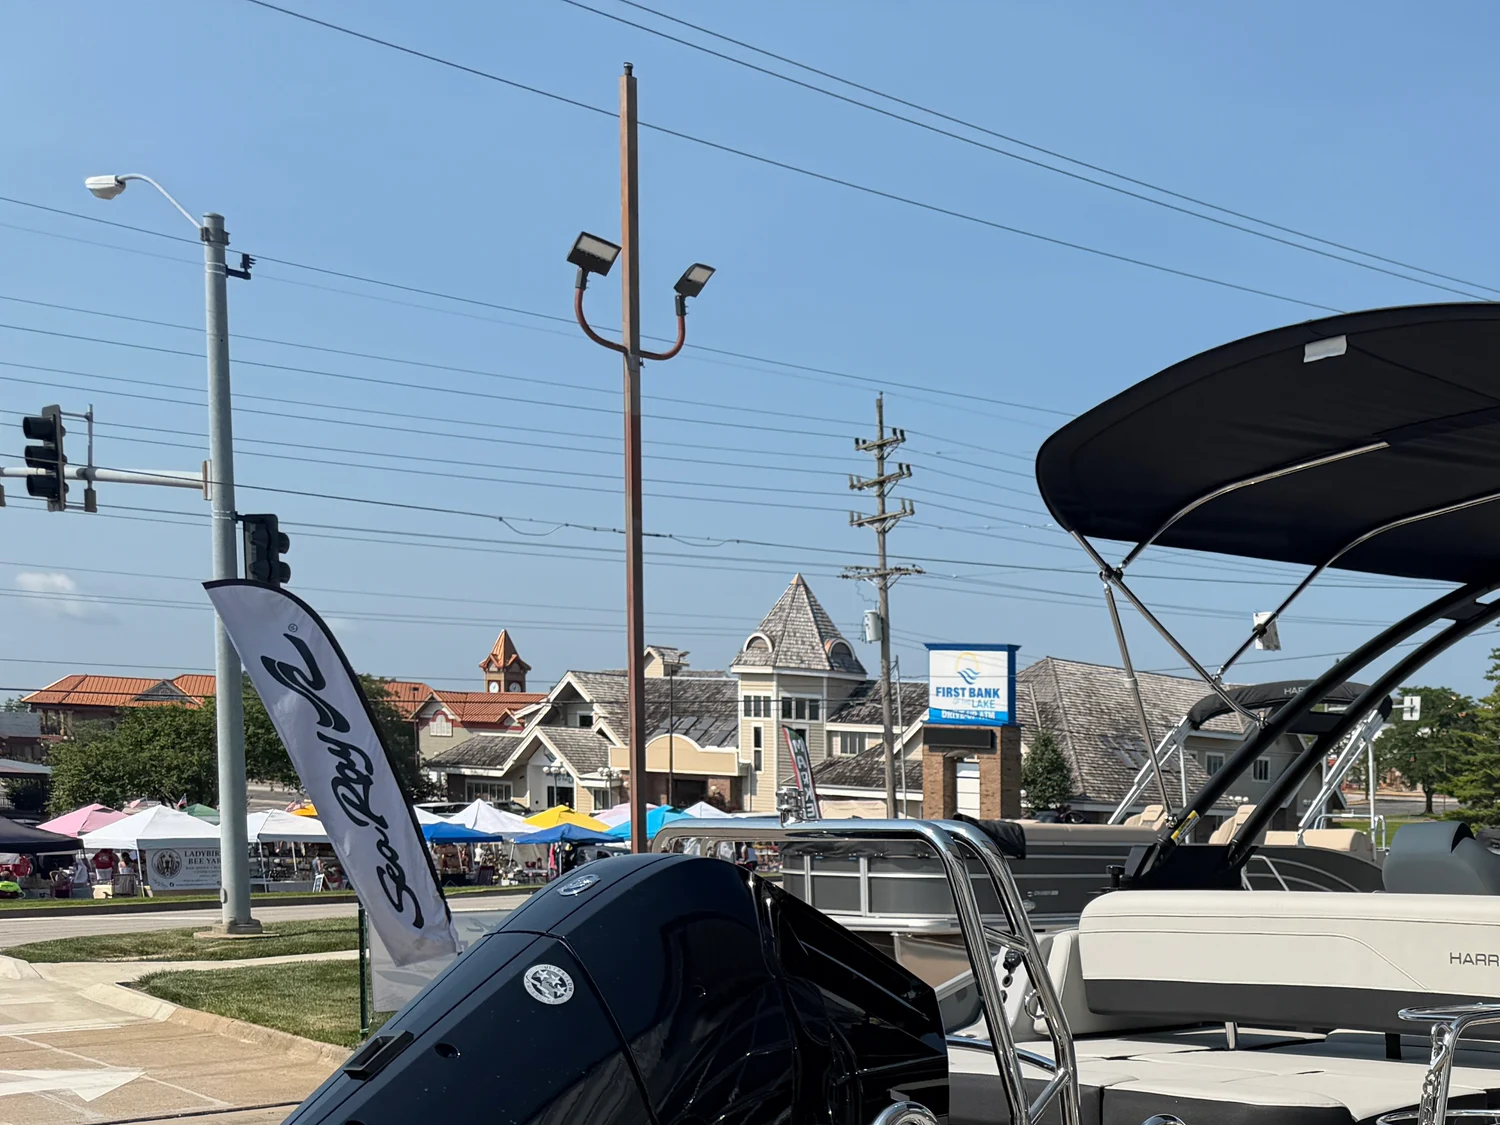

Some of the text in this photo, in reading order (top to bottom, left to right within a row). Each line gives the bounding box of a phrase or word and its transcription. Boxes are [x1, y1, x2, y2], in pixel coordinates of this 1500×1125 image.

[936, 687, 1000, 699] FIRST BANK
[972, 700, 996, 709] LAKE
[317, 731, 425, 930] Sea Ray
